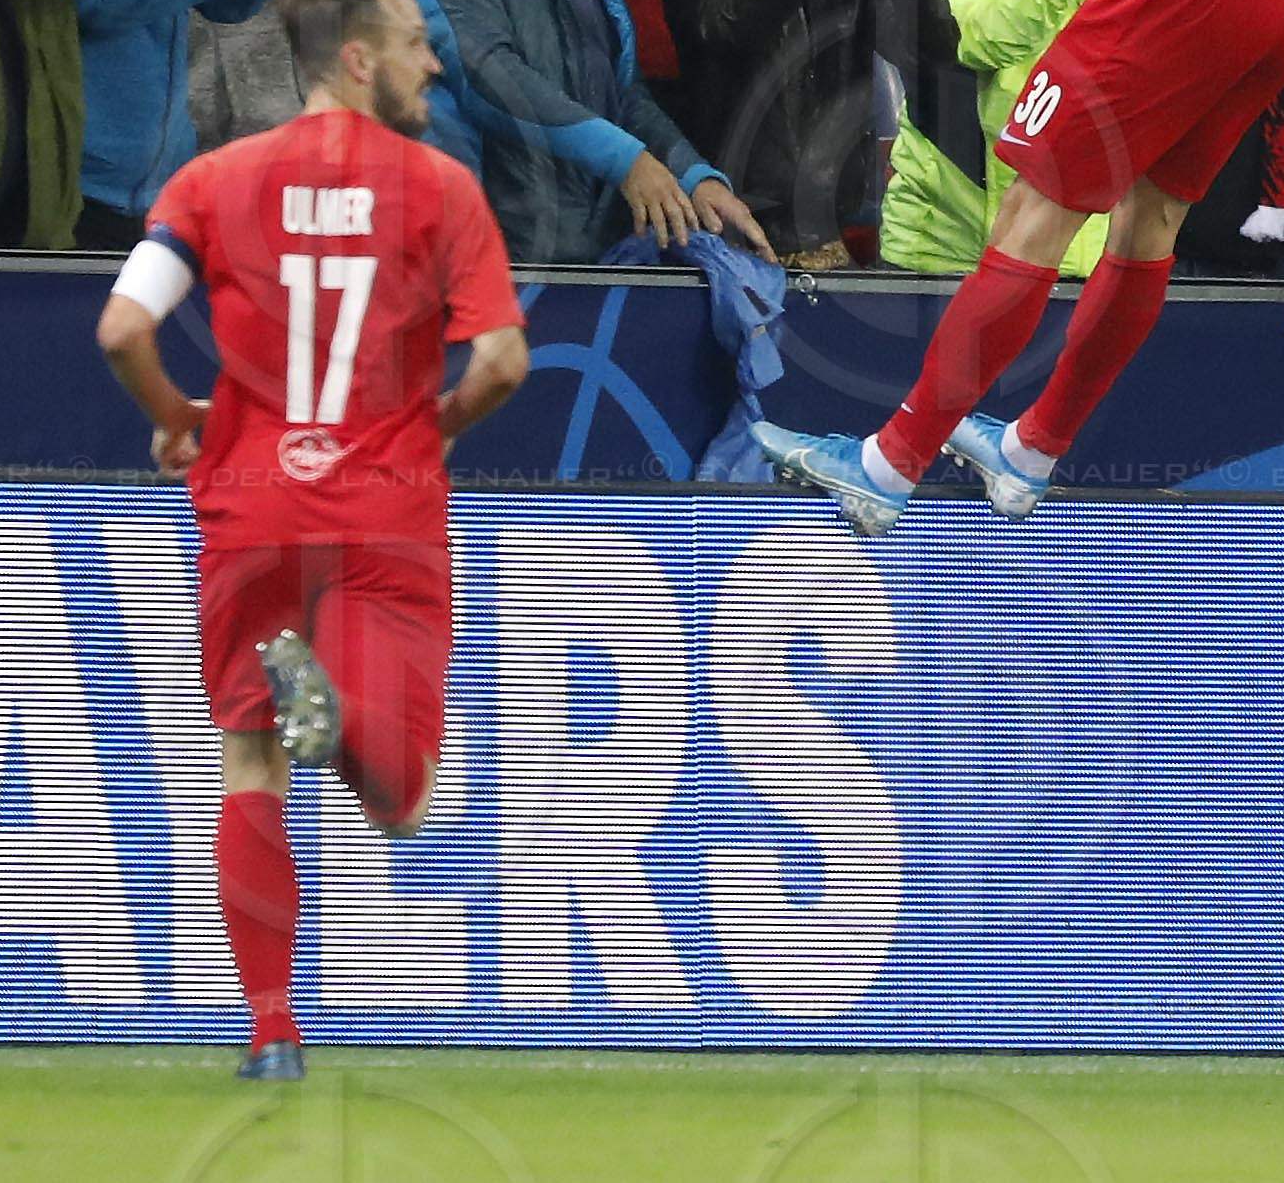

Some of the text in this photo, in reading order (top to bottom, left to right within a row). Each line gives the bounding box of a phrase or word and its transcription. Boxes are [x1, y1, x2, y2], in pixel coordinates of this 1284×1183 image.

[1014, 71, 1062, 137] 30
[281, 185, 374, 236] ULMER
[279, 254, 379, 424] 17
